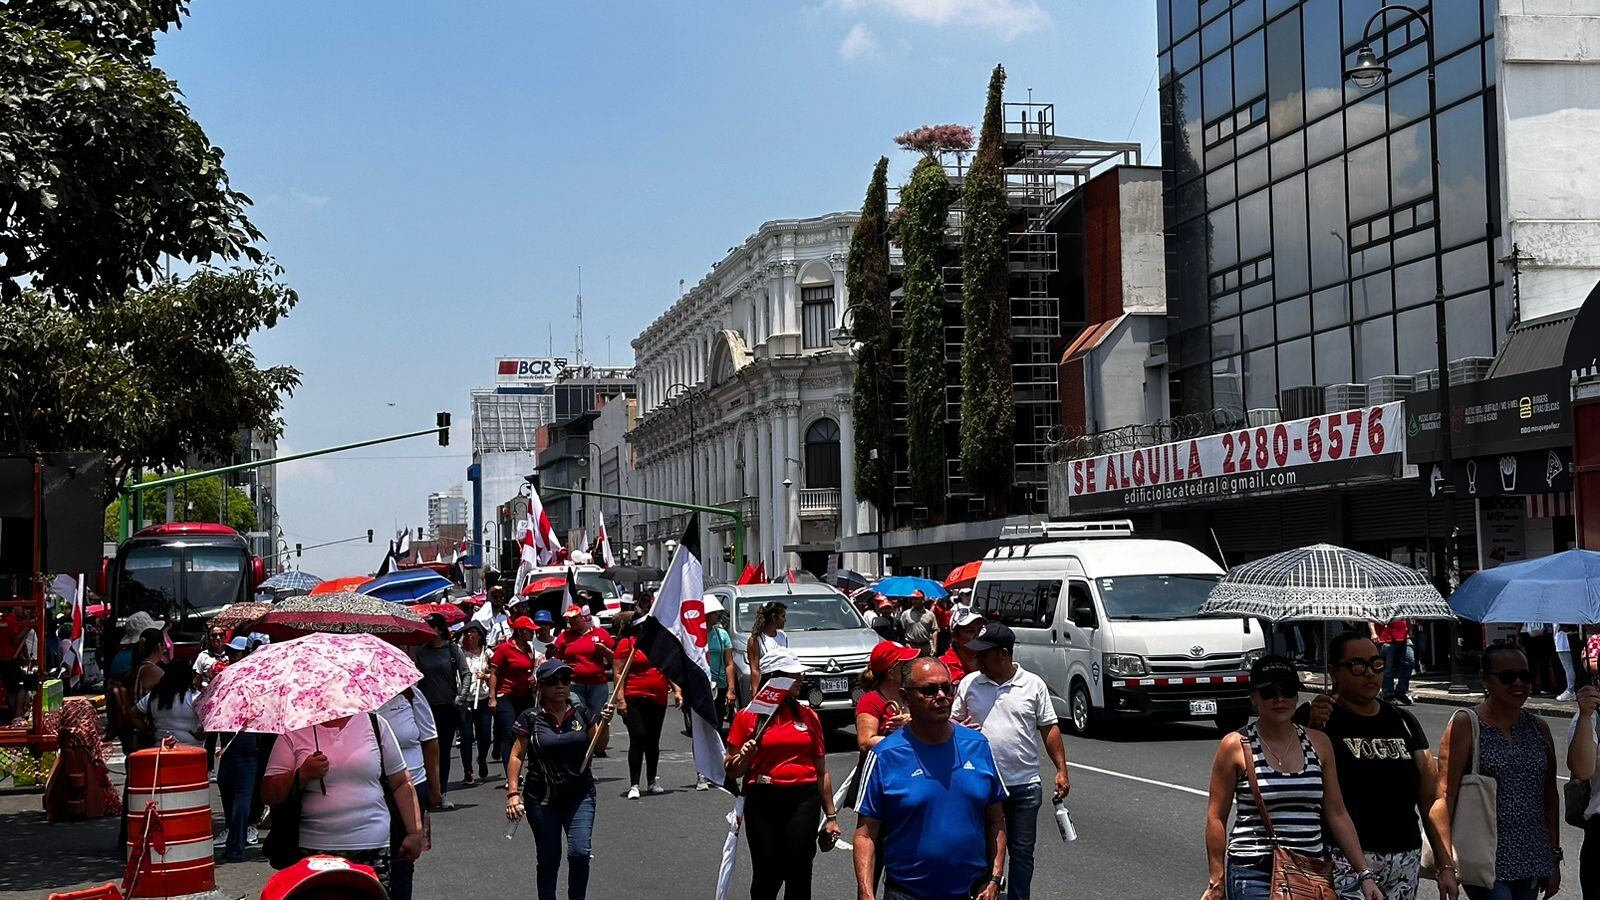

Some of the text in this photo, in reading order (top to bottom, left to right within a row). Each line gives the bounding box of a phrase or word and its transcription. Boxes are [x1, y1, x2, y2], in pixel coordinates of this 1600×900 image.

[518, 360, 552, 375] BCR
[1074, 406, 1385, 495] SE ALQUILA 2280-6576
[1124, 471, 1297, 504] edificiolacatedral@gmail.com
[760, 689, 781, 701] PSE
[1343, 738, 1412, 759] VOGUE
